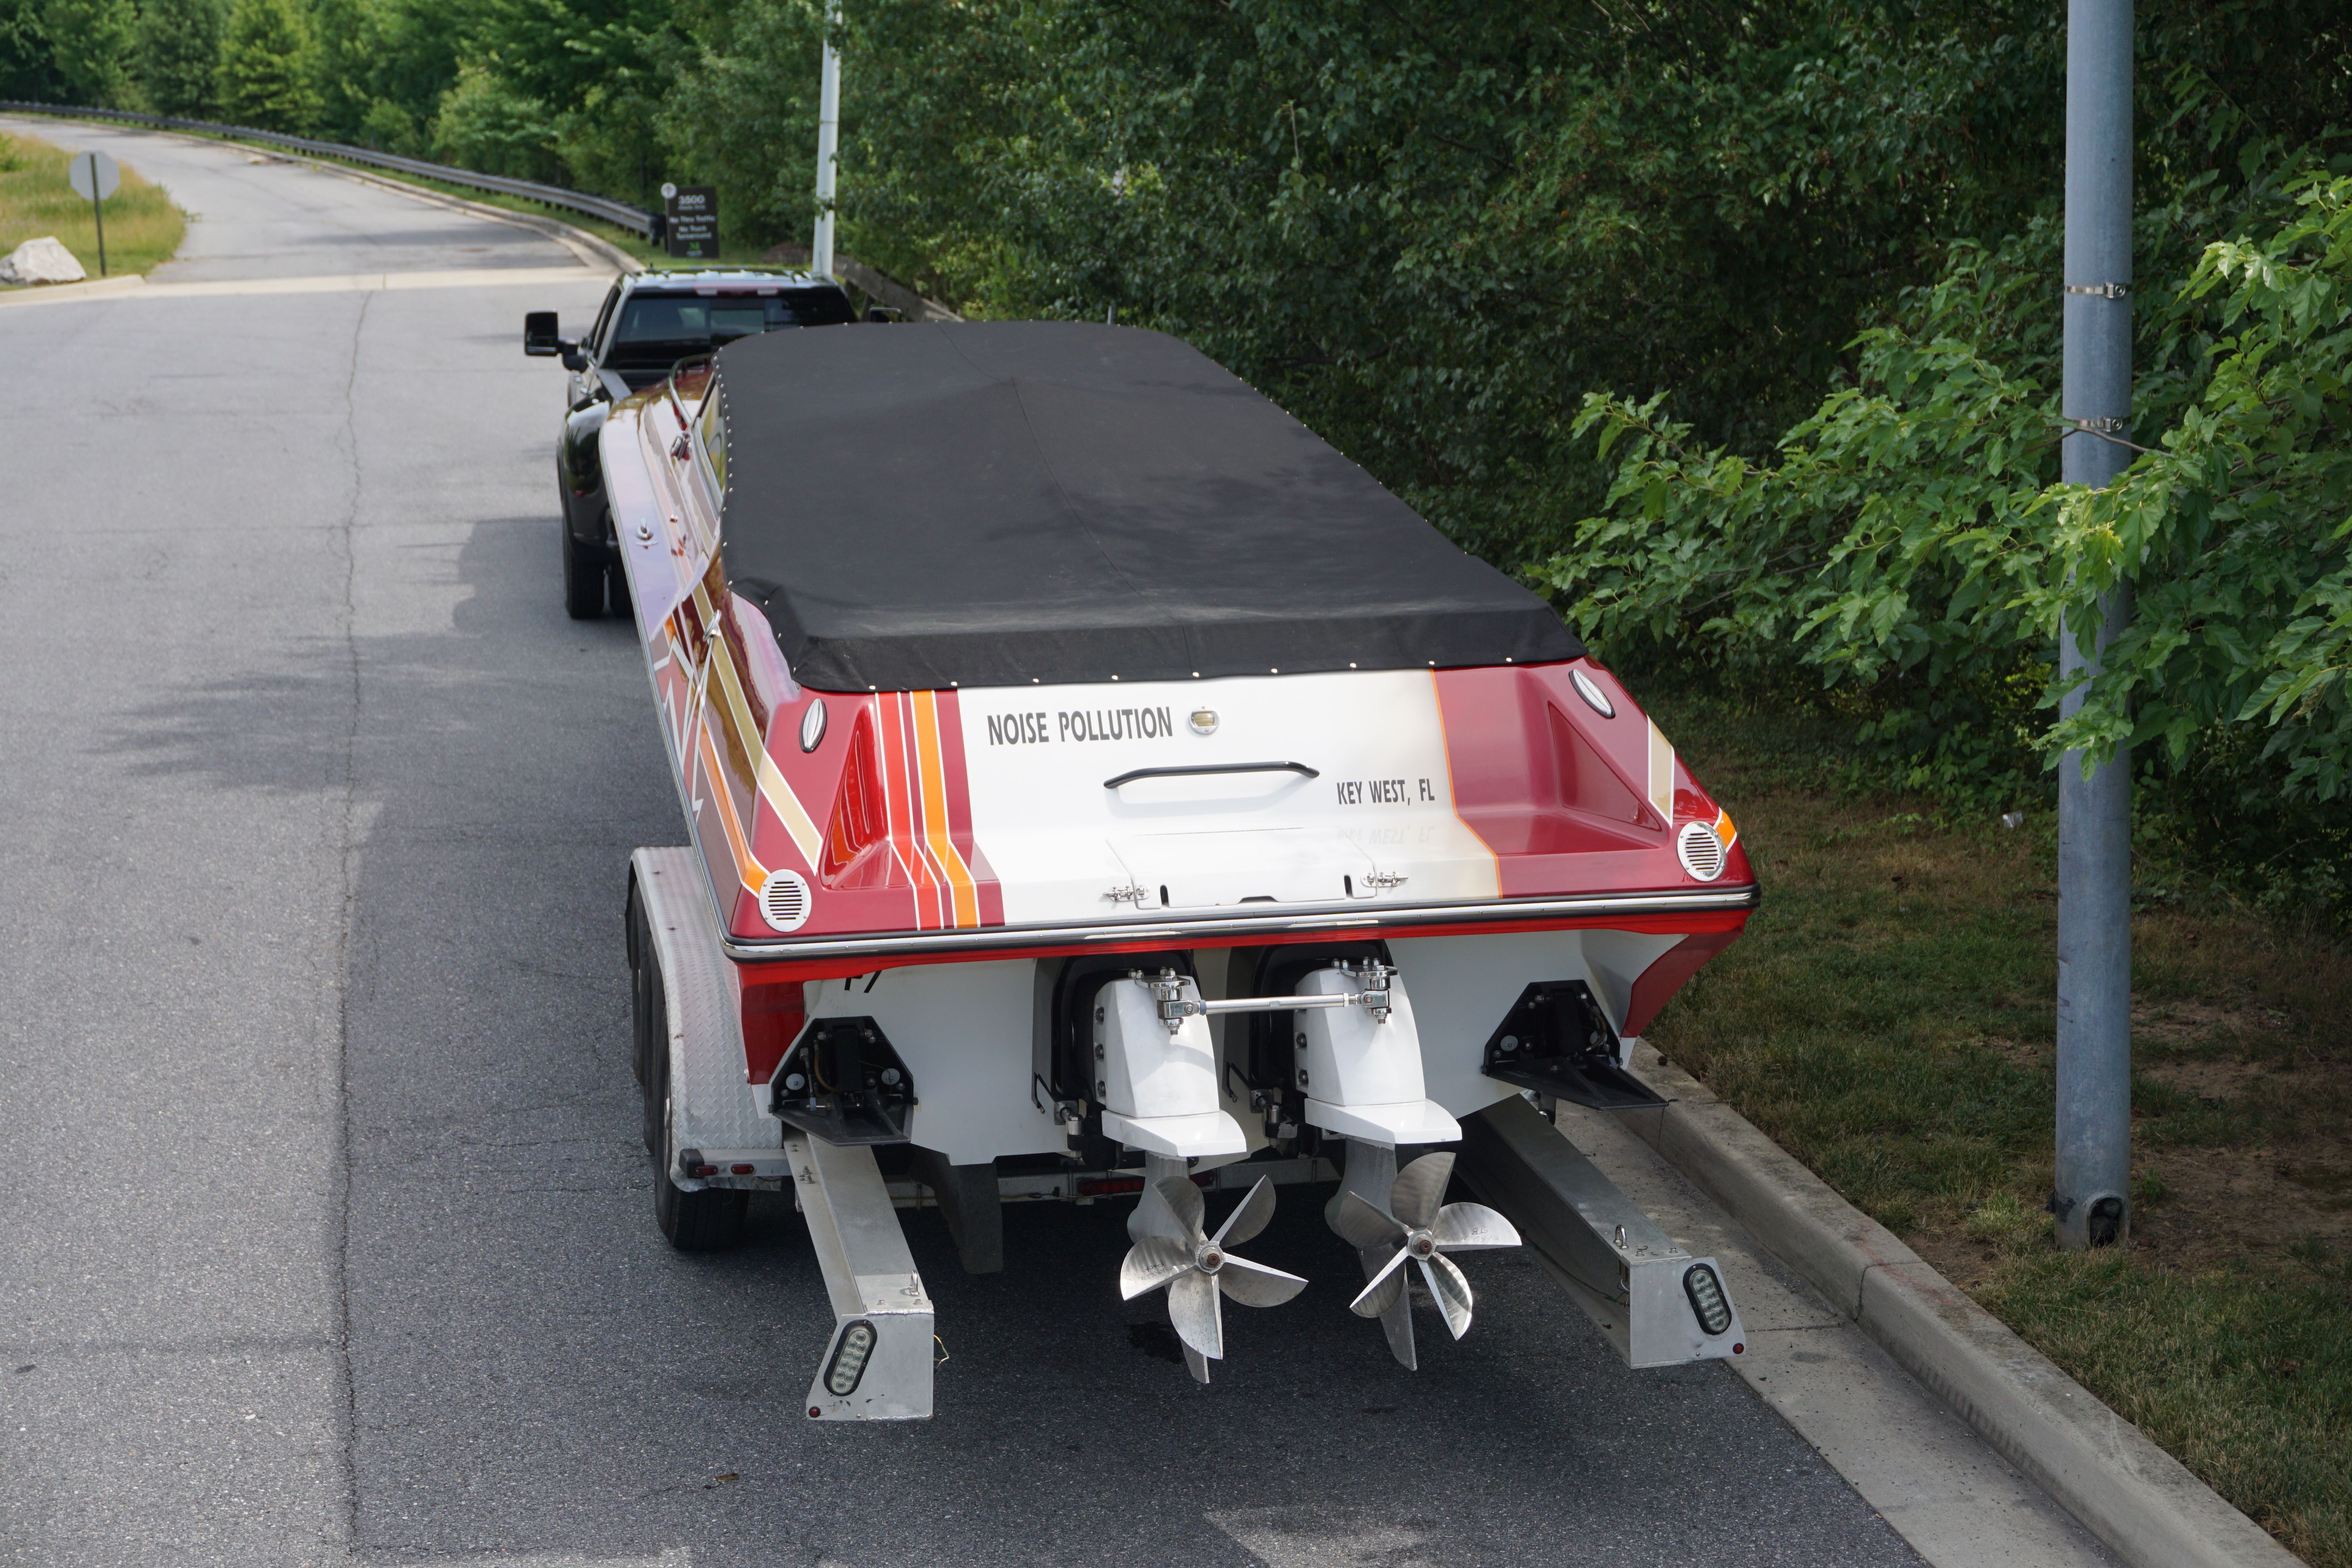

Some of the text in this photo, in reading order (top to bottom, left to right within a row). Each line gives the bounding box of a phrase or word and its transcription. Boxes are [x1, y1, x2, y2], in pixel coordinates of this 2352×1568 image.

[679, 195, 705, 204] 3500
[987, 706, 1173, 746] NOISE POLLUTION
[1336, 778, 1435, 806] KEY WEST, FL
[1472, 1226, 1489, 1235] STB
